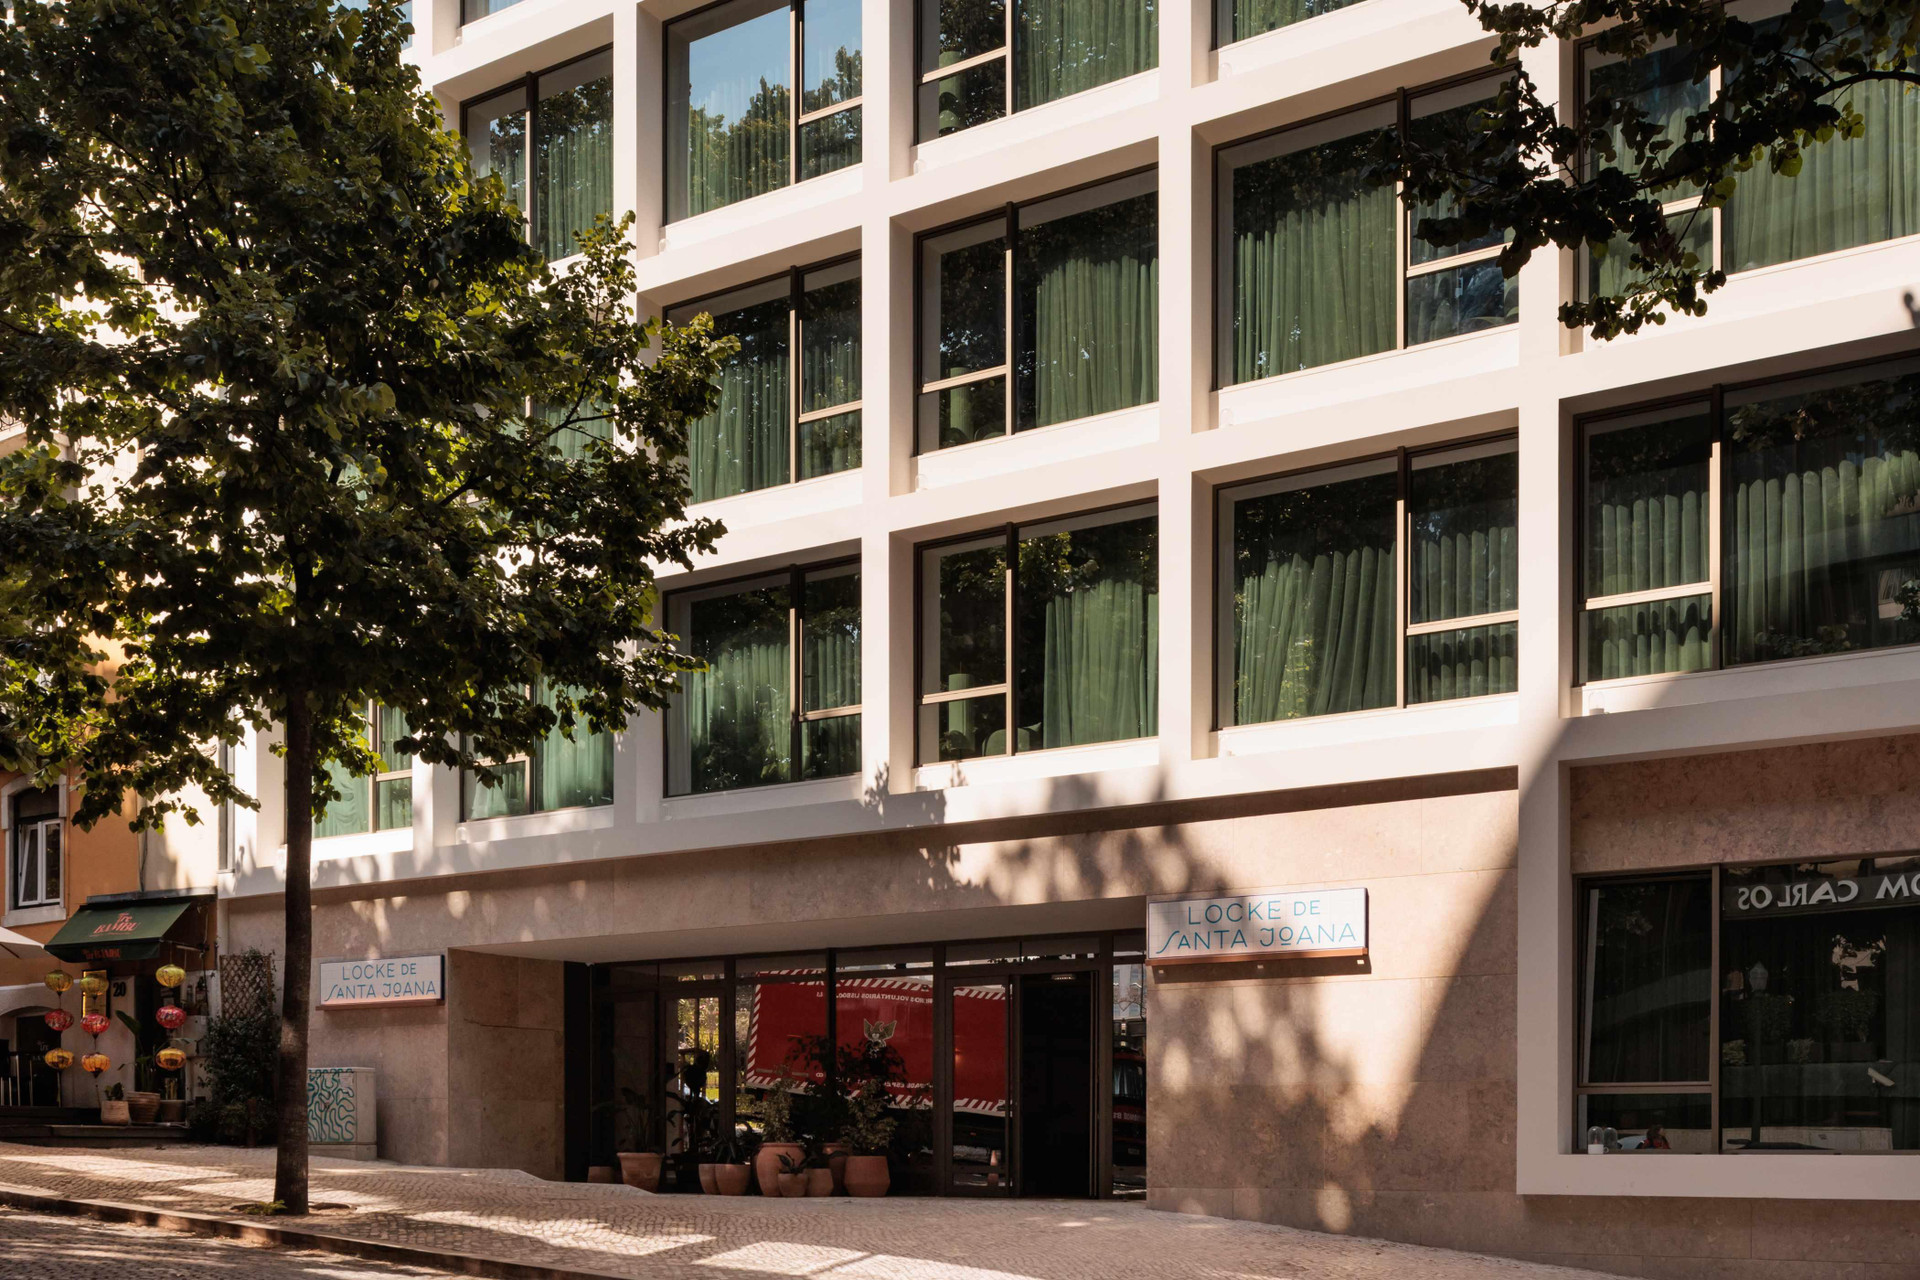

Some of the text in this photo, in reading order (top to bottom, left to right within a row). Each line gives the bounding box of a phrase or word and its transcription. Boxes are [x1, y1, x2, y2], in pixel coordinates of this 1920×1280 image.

[1188, 900, 1321, 925] LOCKE DE
[1156, 923, 1356, 954] SANTA JOANA
[342, 963, 417, 980] LOCKE DE
[113, 981, 126, 997] 20
[324, 981, 436, 1001] SANTA JOANA
